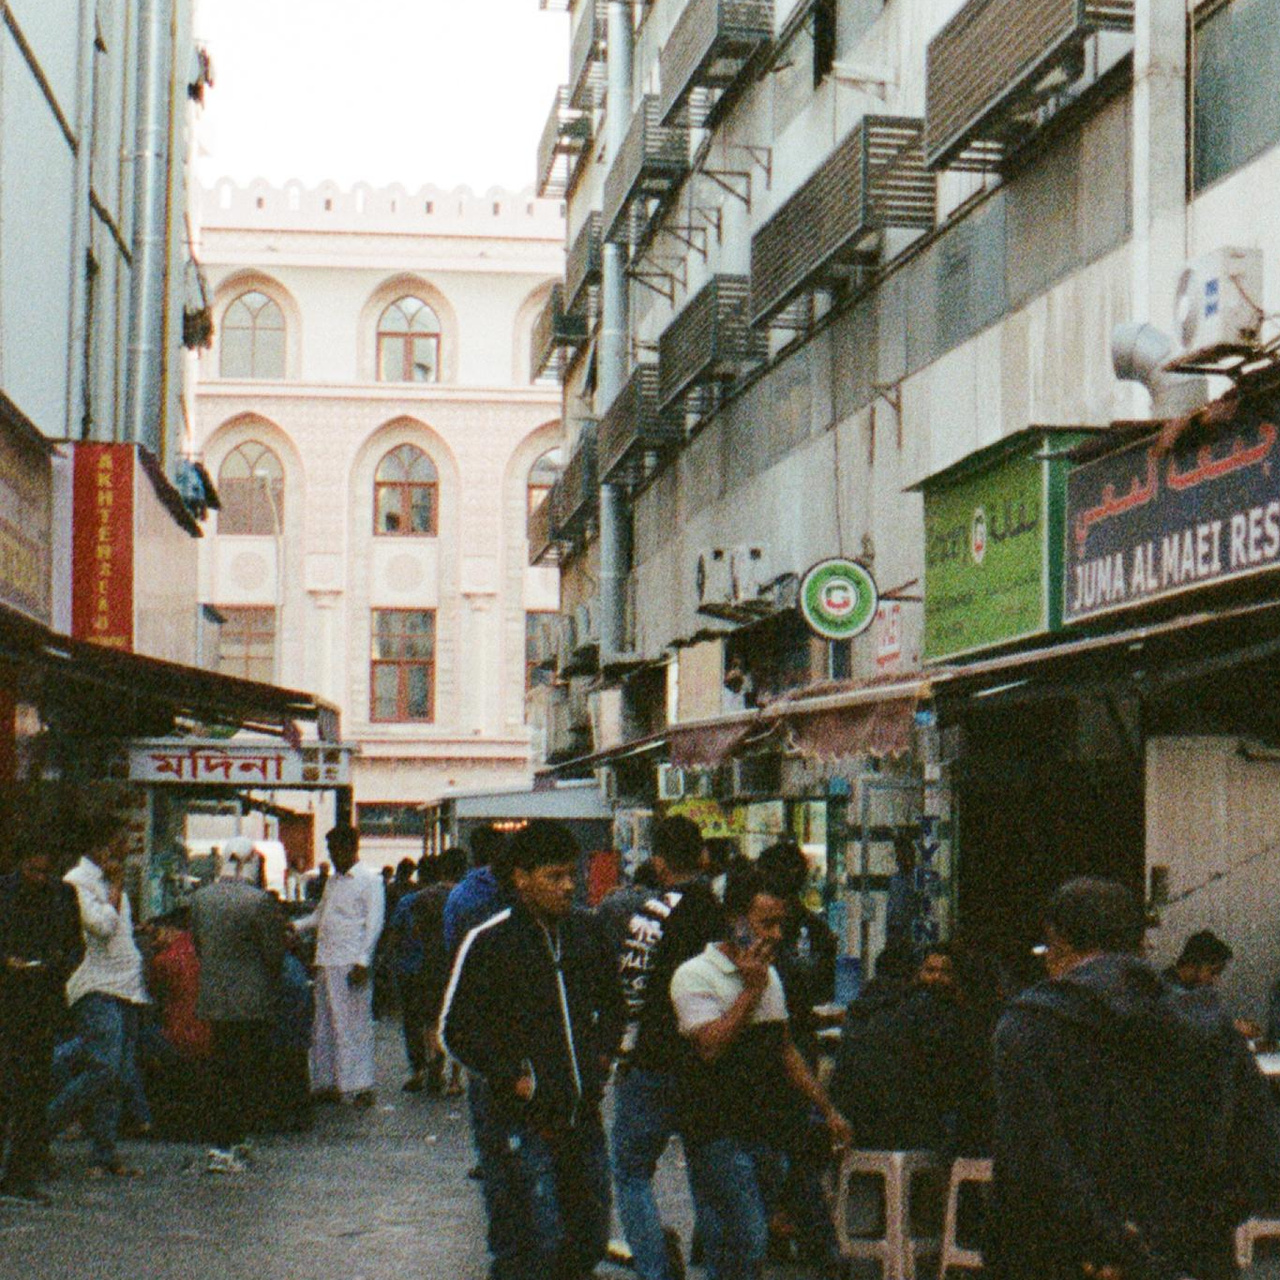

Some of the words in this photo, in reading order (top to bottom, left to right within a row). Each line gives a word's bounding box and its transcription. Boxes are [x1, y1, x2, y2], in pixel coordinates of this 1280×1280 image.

[1072, 553, 1126, 611] JUMA
[1131, 539, 1160, 597] AL
[1161, 520, 1222, 585] MAEI
[149, 745, 286, 780] মদিনা
